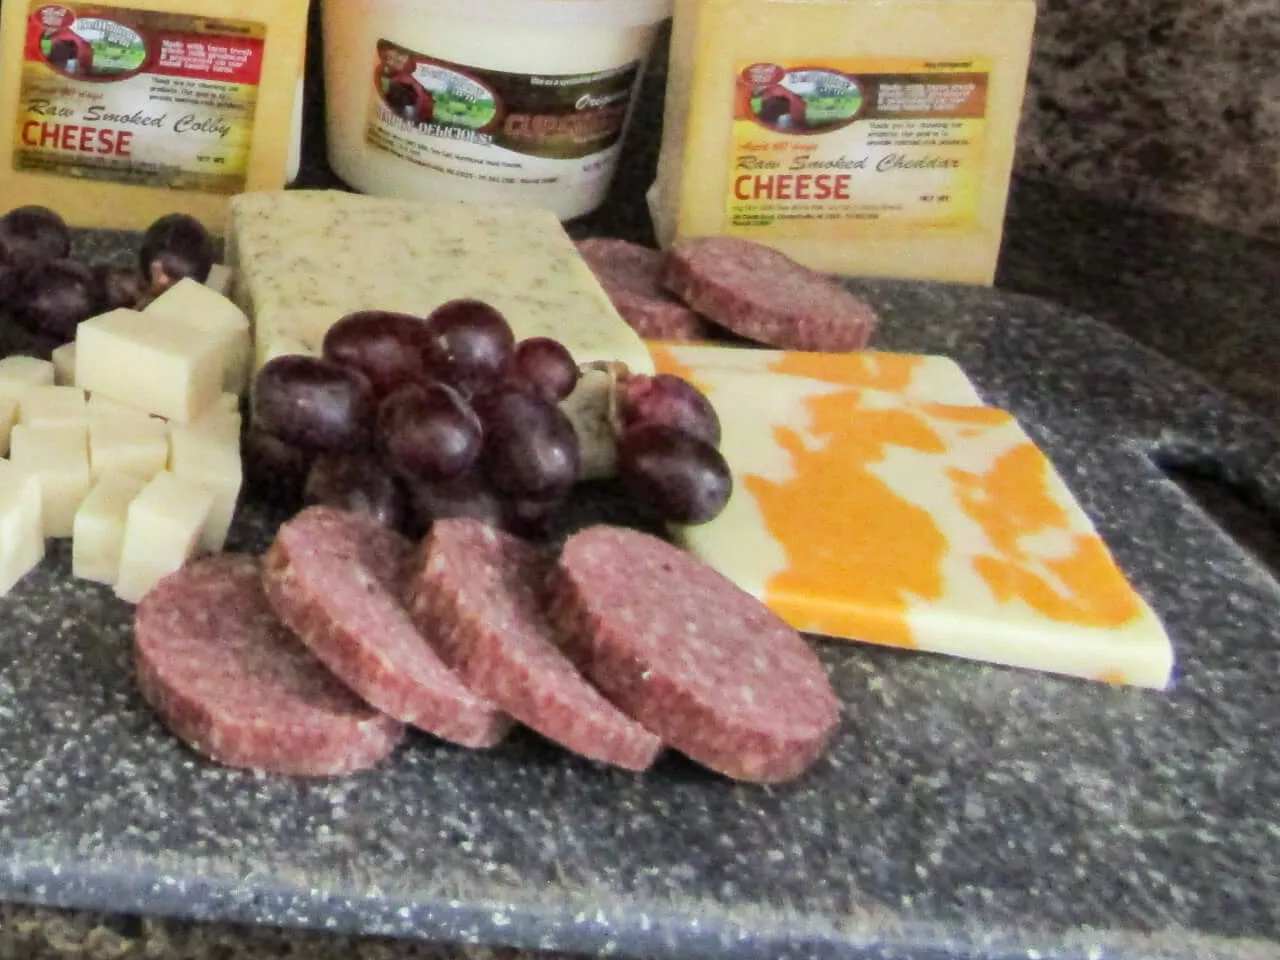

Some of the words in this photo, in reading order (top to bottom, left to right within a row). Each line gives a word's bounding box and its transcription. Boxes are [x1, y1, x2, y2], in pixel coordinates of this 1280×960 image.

[27, 97, 74, 118] Raw
[82, 105, 167, 128] Smoked
[173, 114, 232, 138] Colby
[22, 120, 133, 158] CHEESE
[735, 155, 779, 170] Raw
[789, 154, 868, 171] Smoked
[875, 152, 961, 173] Cheddar
[733, 174, 852, 200] CHEESE
